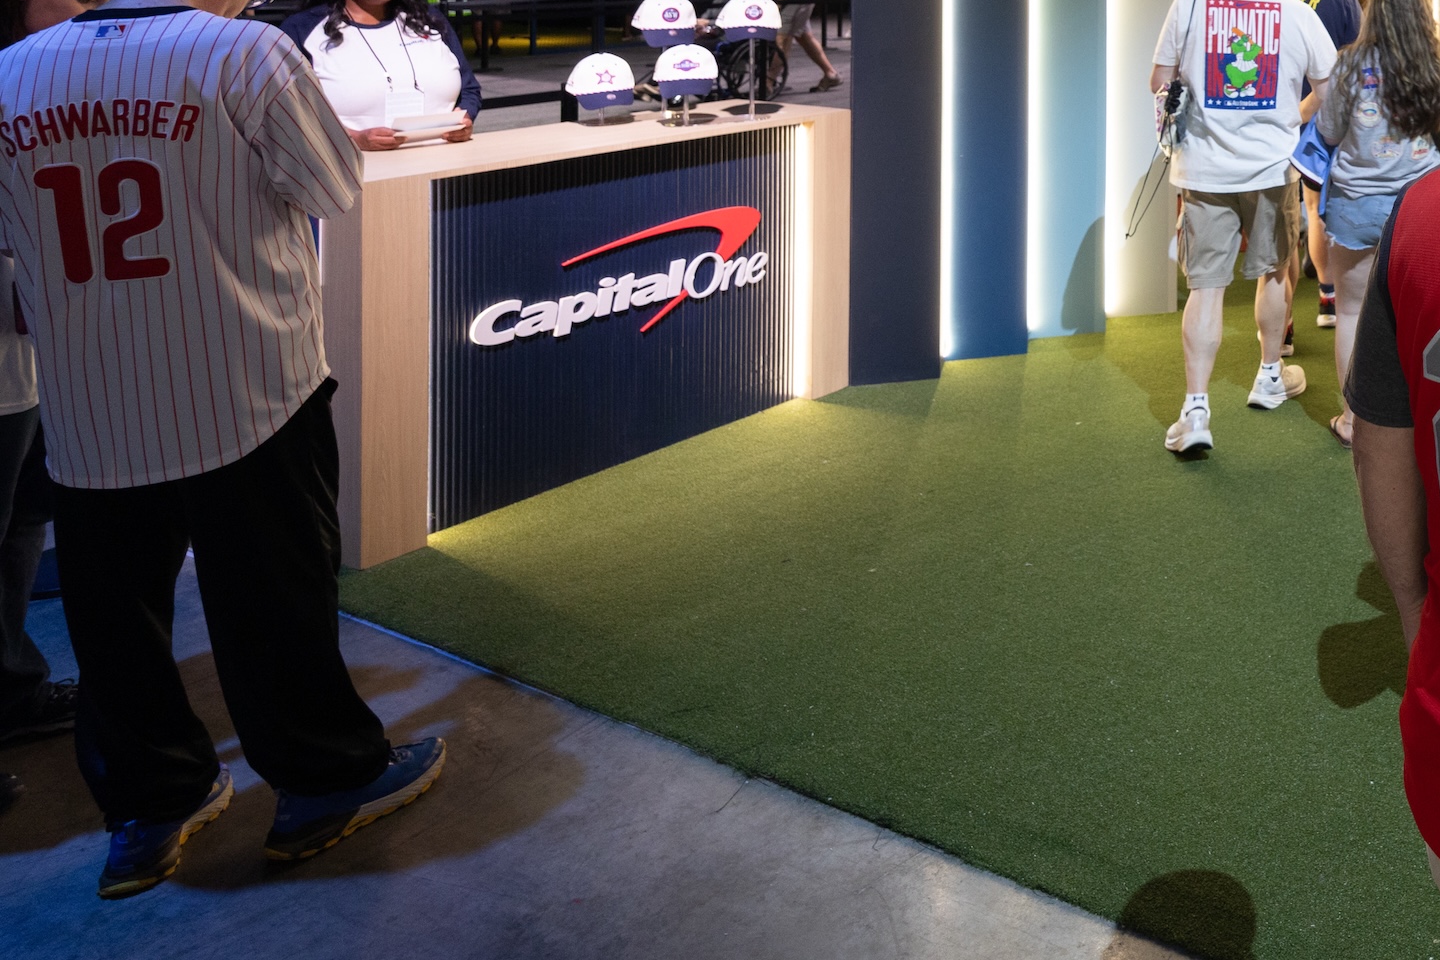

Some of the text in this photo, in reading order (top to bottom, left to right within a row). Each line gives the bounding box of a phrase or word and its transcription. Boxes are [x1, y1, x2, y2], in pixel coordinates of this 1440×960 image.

[1207, 6, 1280, 55] PHANATIC
[0, 98, 200, 158] SCHWARBER
[33, 157, 171, 284] 12
[469, 251, 769, 346] Capital One
